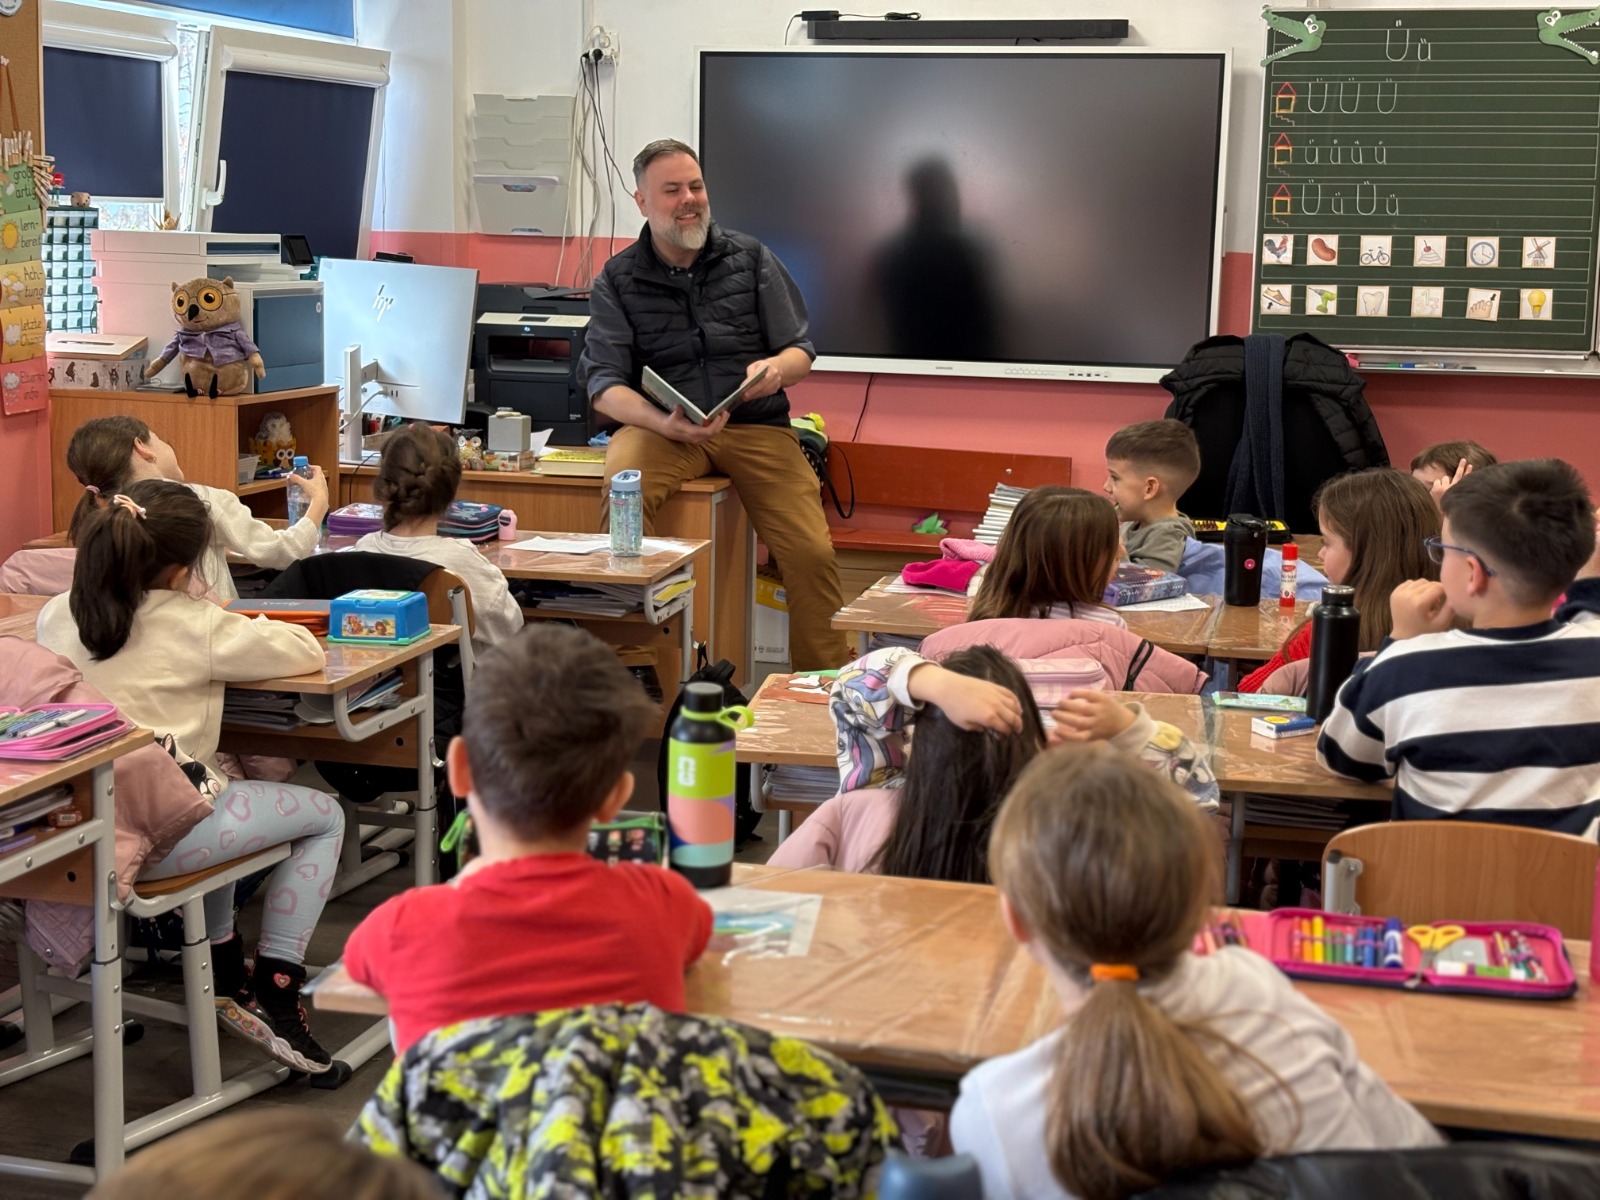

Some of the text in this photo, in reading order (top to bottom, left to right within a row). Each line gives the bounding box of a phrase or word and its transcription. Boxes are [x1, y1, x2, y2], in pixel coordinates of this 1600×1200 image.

[1385, 19, 1431, 62] Ü ü
[1307, 77, 1397, 114] Ü Ü Ü
[1301, 179, 1399, 216] Ü ü Ü ü
[24, 286, 44, 301] tung
